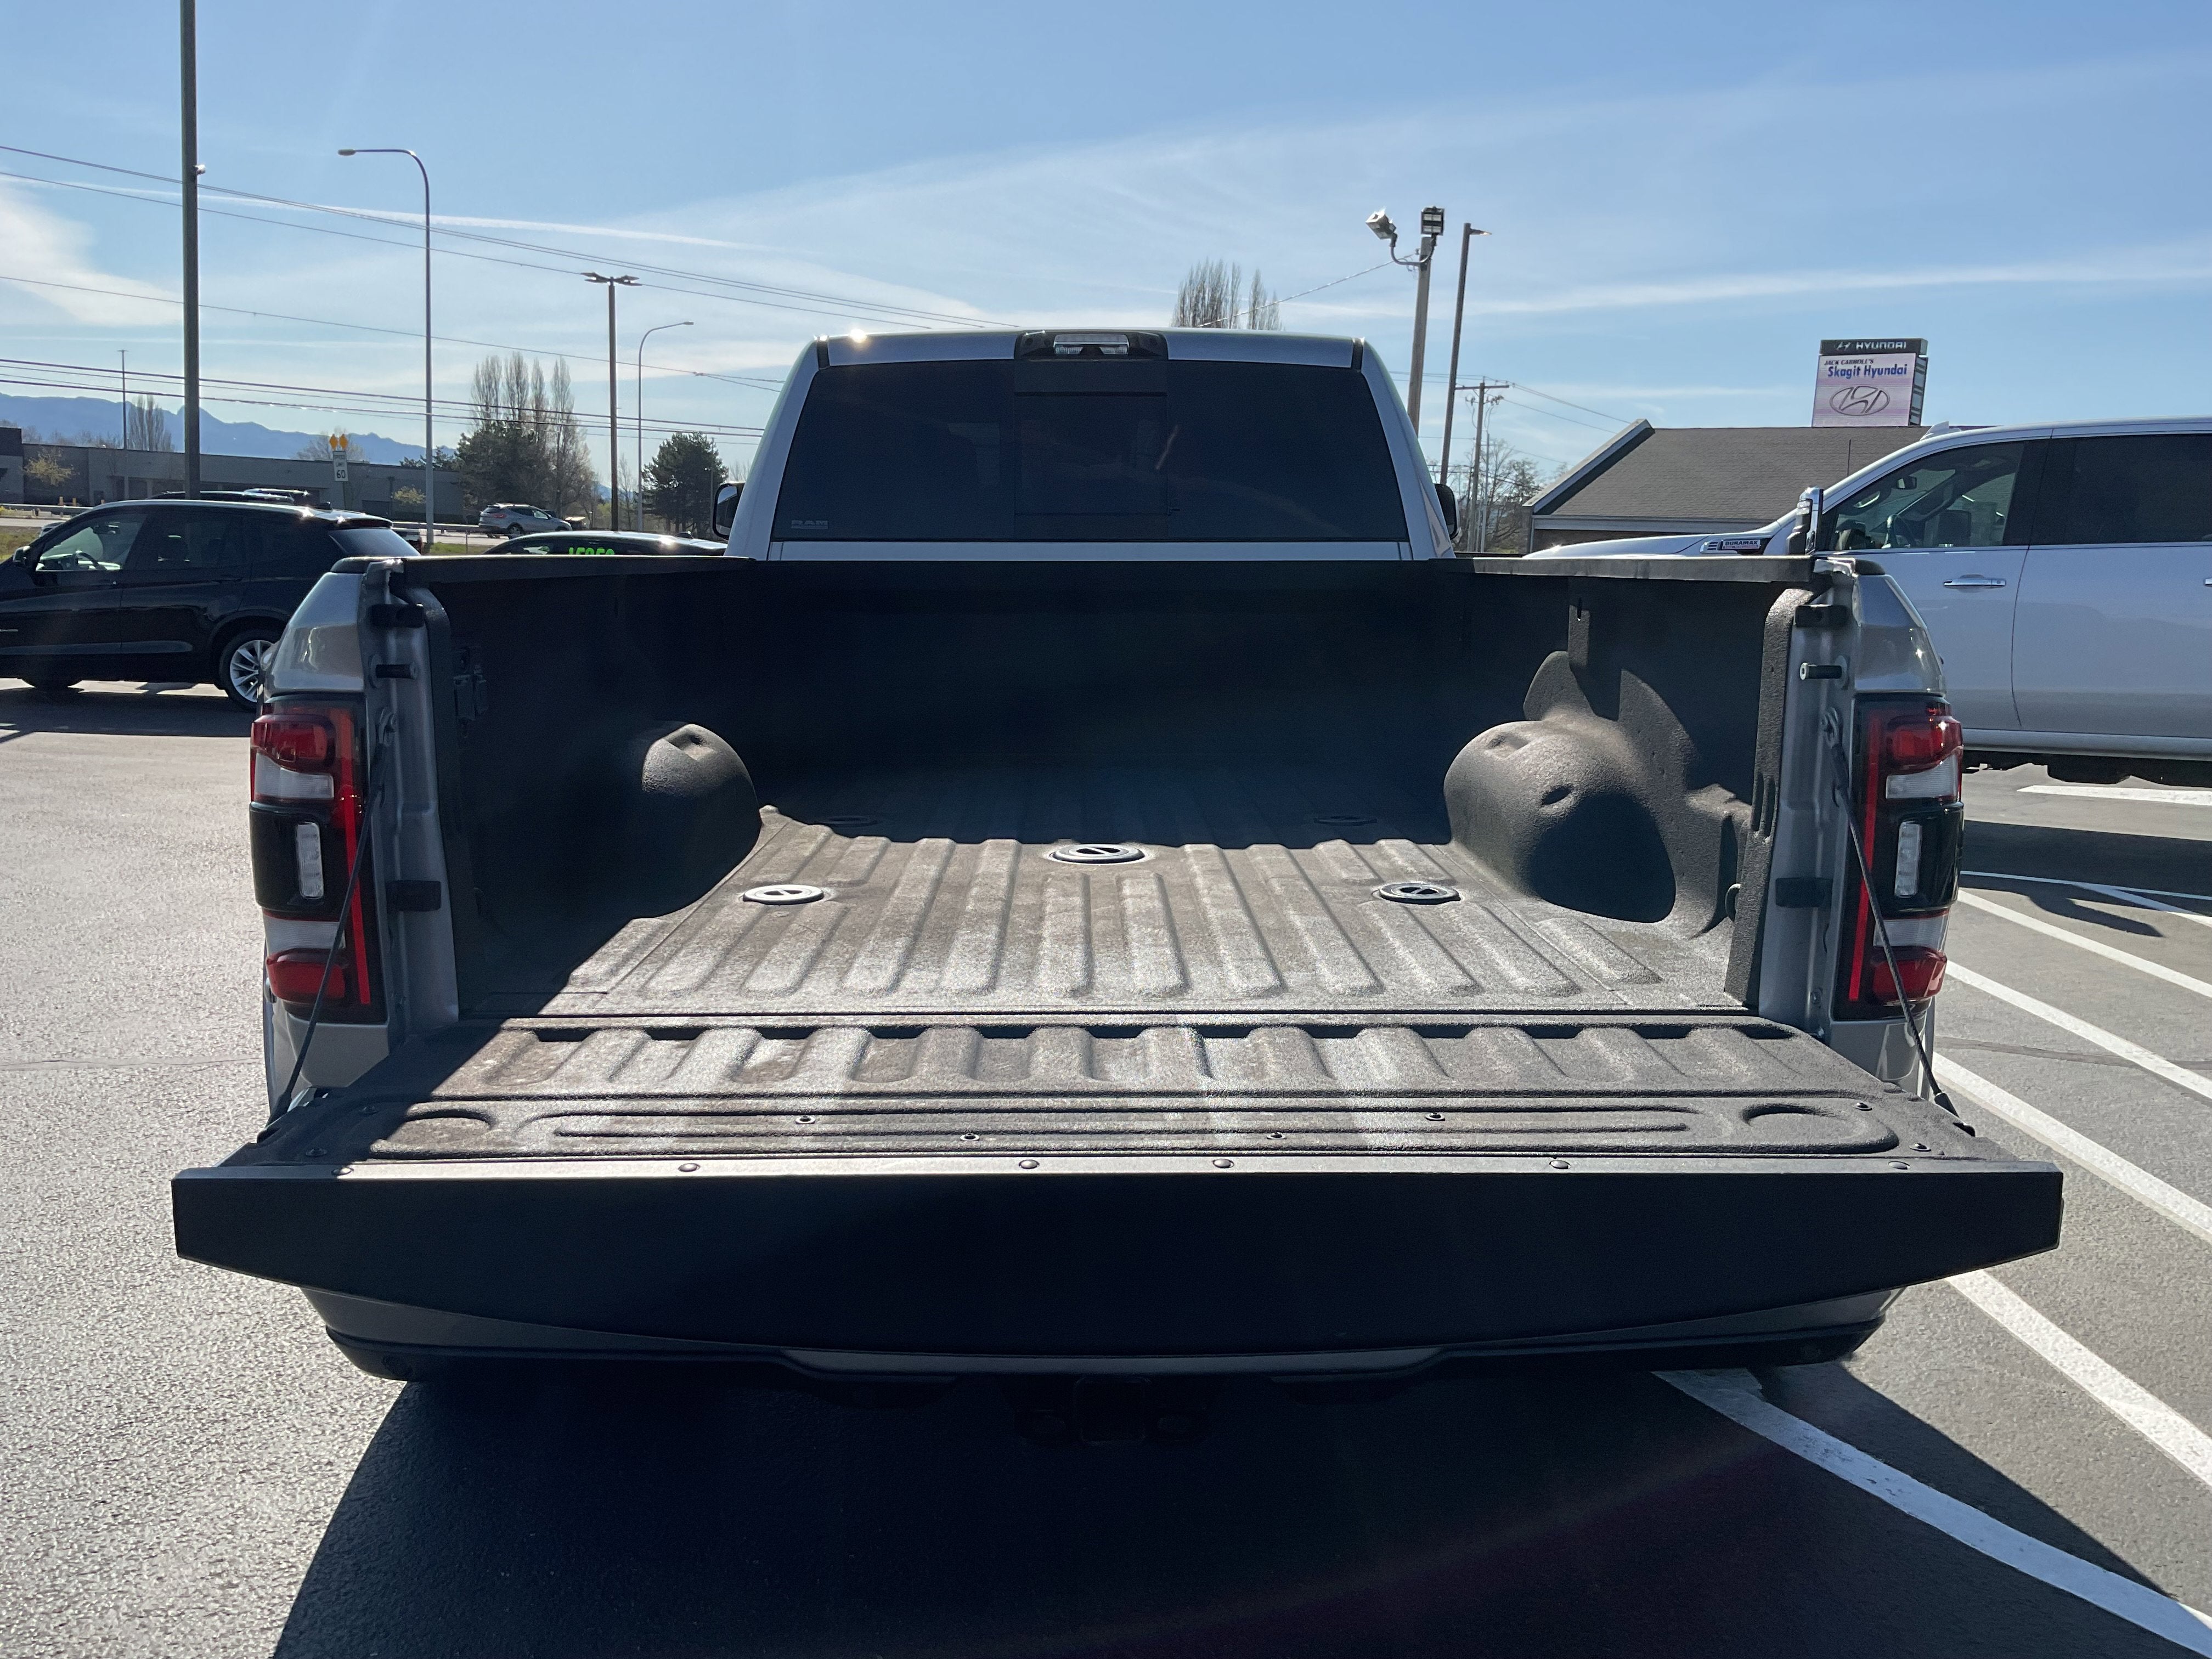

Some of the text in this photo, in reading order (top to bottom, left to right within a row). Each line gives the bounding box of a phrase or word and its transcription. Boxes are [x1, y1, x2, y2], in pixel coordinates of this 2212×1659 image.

[1856, 341, 1906, 349] HYUNDAI
[1827, 364, 1908, 379] Skagit Hyundai
[336, 470, 346, 479] 60
